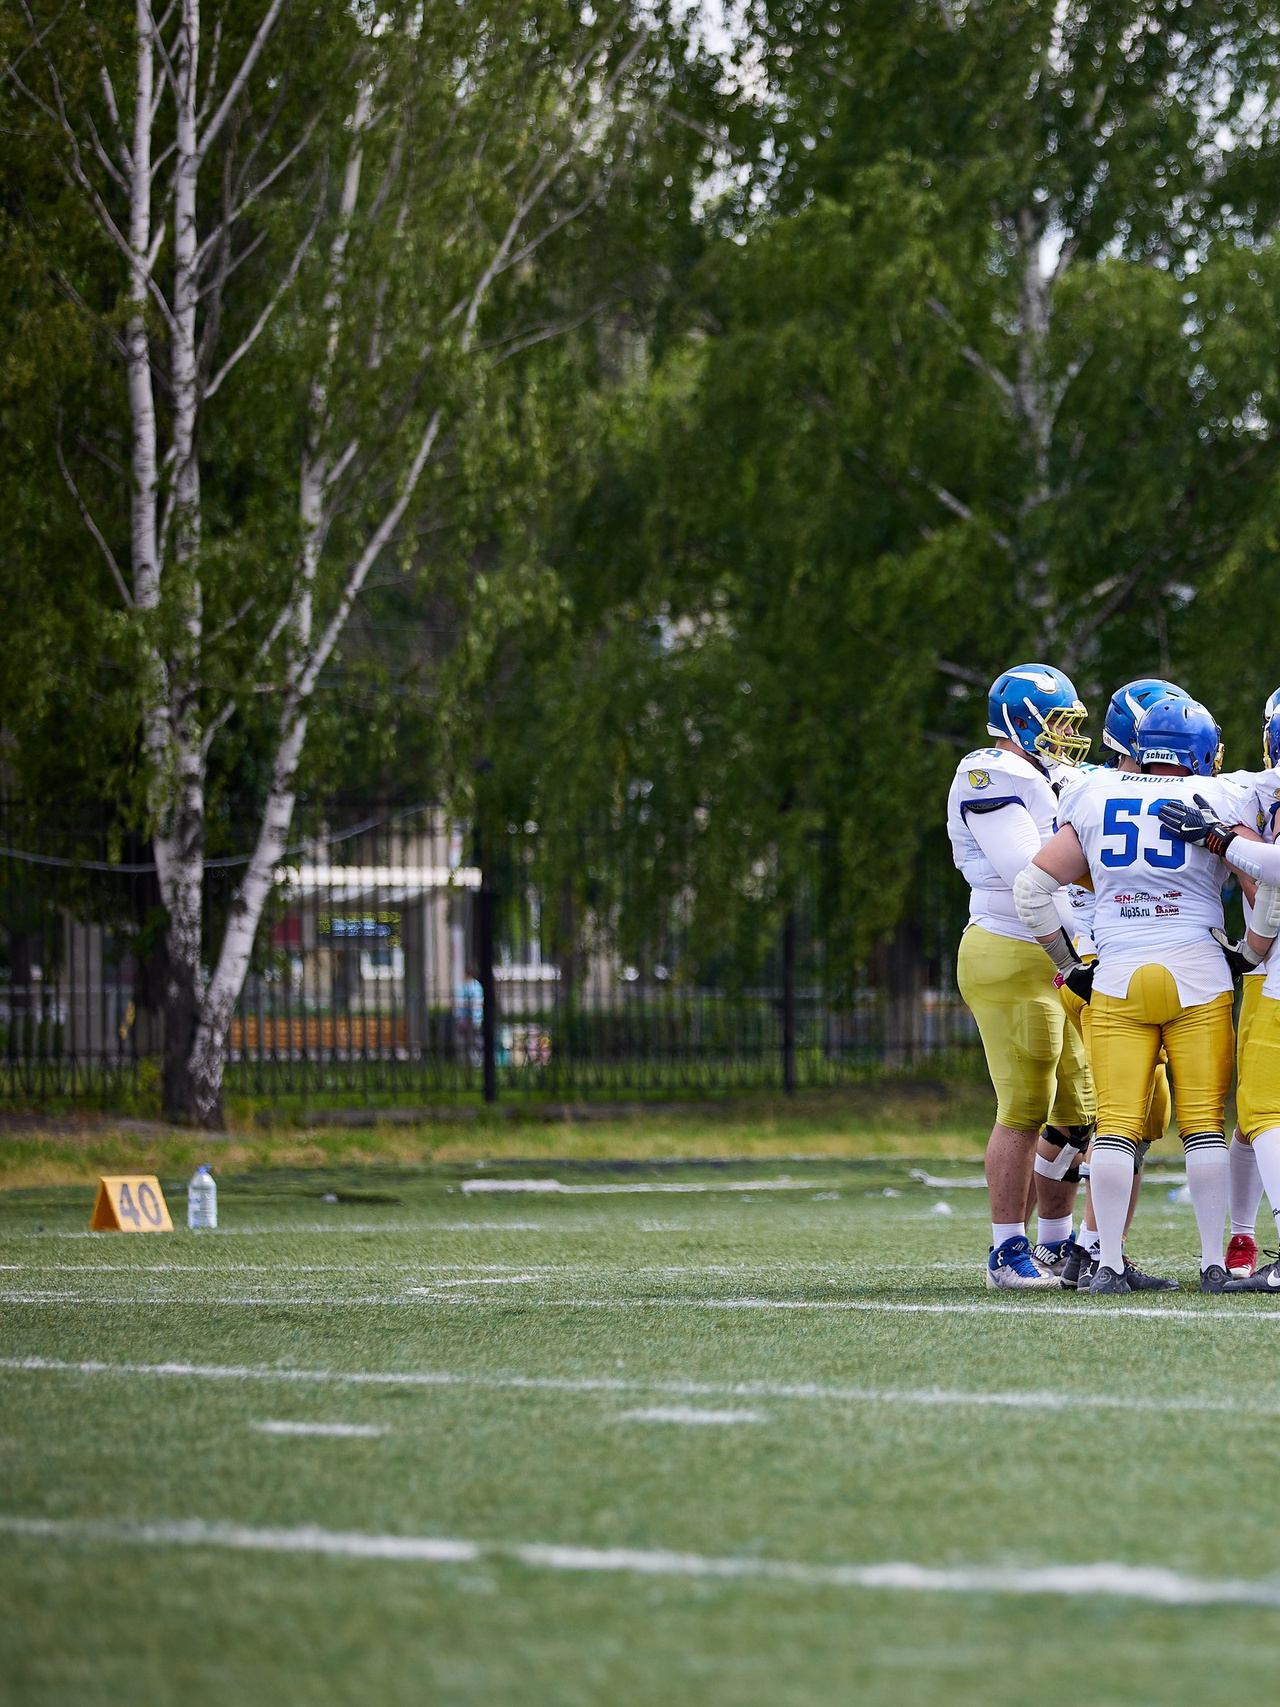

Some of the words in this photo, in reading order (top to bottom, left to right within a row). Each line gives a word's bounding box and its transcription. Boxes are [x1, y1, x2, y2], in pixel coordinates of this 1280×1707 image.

[1100, 798, 1187, 870] 53
[1120, 906, 1151, 919] Alp35.ru
[120, 1183, 162, 1227] 40
[1033, 1245, 1059, 1266] NIKE
